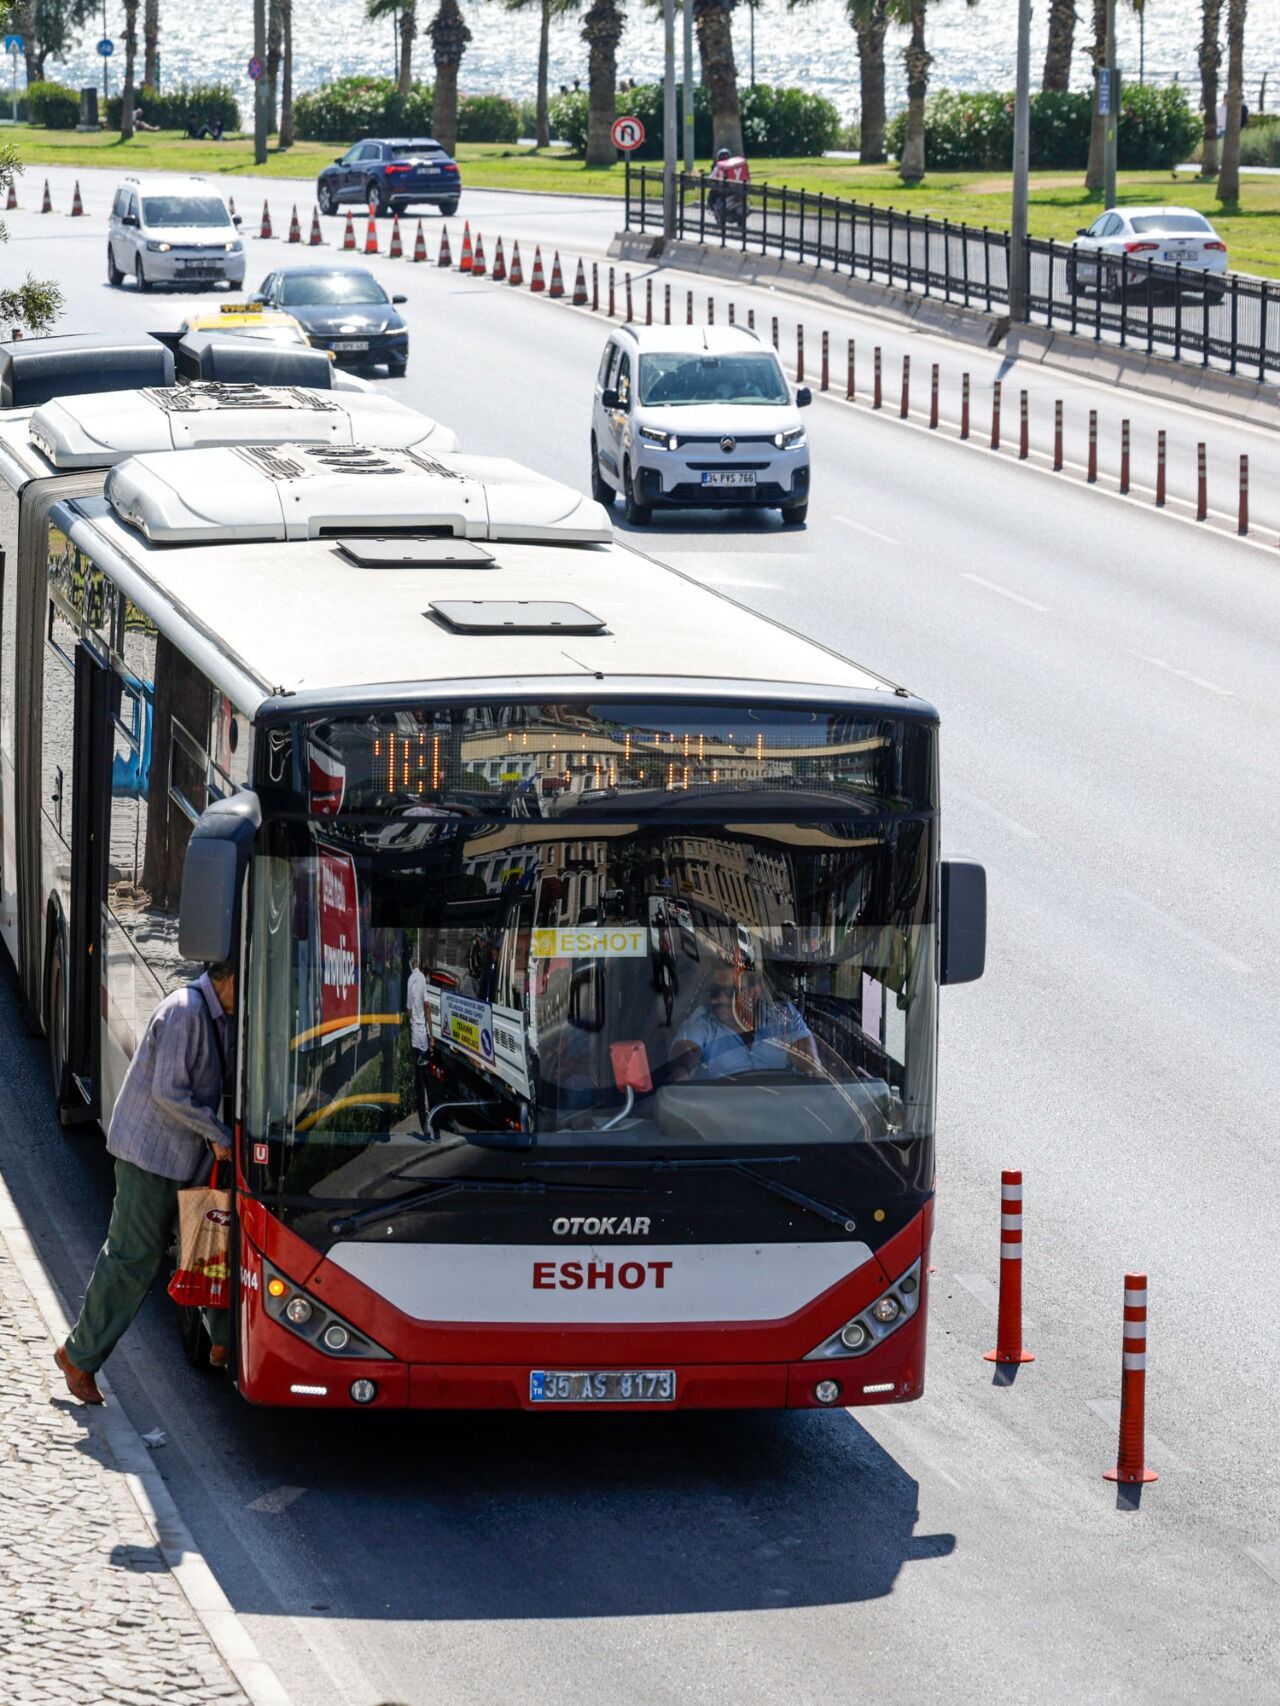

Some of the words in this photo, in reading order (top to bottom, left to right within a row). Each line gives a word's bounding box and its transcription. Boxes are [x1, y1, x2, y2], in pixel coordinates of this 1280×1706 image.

[708, 474, 717, 483] 34
[720, 474, 735, 483] PVS
[739, 474, 753, 483] 766
[561, 933, 642, 952] ESHOT
[256, 1147, 265, 1160] U
[552, 1217, 650, 1235] OTOKAR
[533, 1262, 673, 1289] ESHOT
[545, 1376, 570, 1398] 35
[582, 1375, 606, 1398] AS
[619, 1374, 672, 1397] 8173
